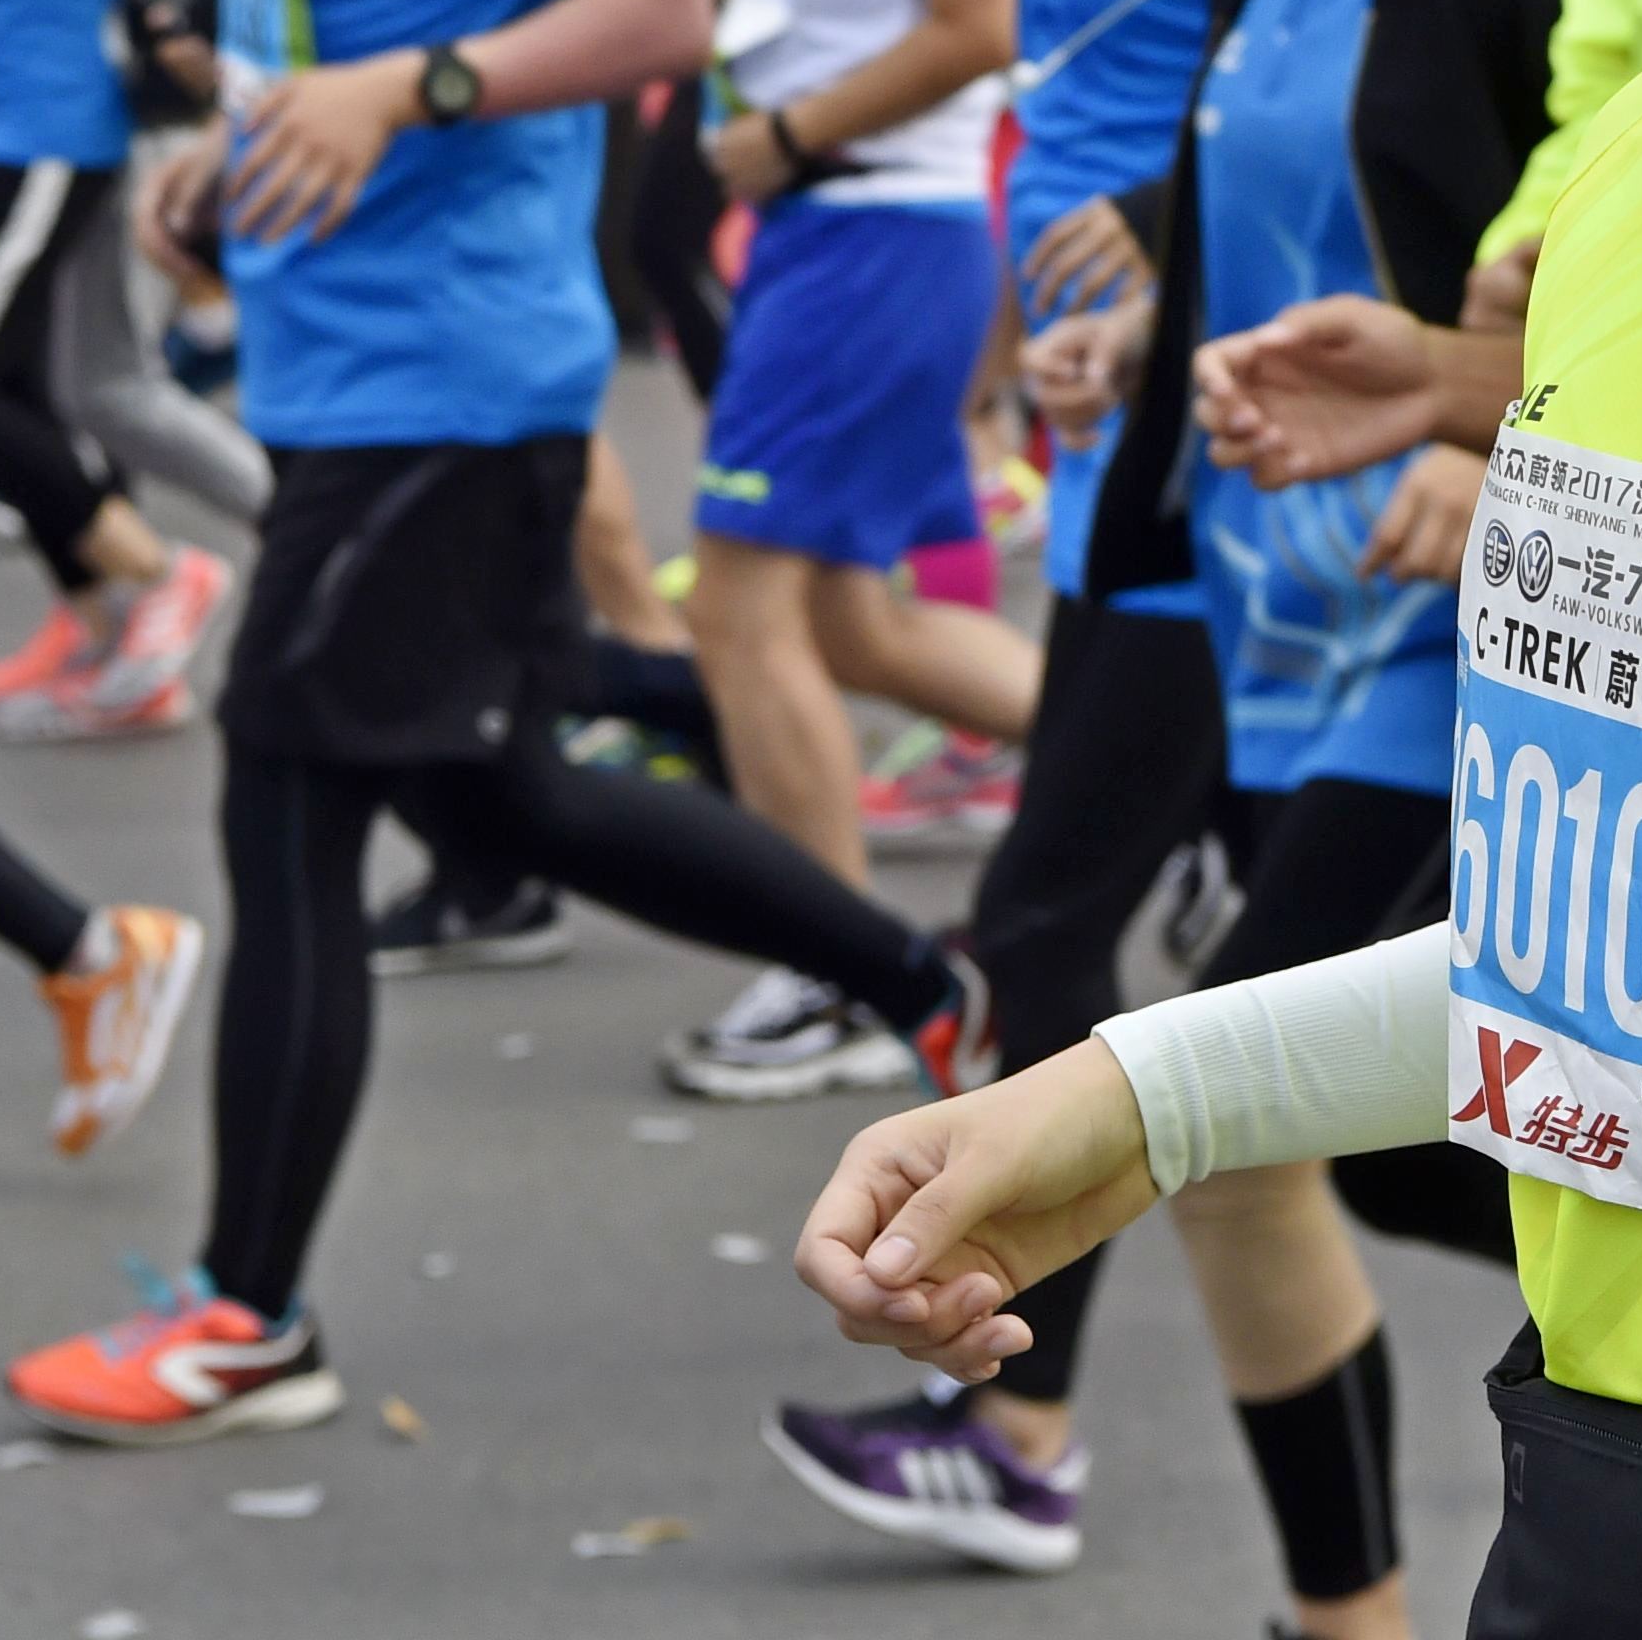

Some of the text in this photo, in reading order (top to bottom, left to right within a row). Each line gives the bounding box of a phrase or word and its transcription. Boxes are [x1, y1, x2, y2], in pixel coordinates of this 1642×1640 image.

[1526, 494, 1559, 516] C-TREK
[1564, 505, 1627, 535] SHENYANG
[1475, 606, 1592, 695] C-TREK
[1515, 1094, 1631, 1171] 特步
